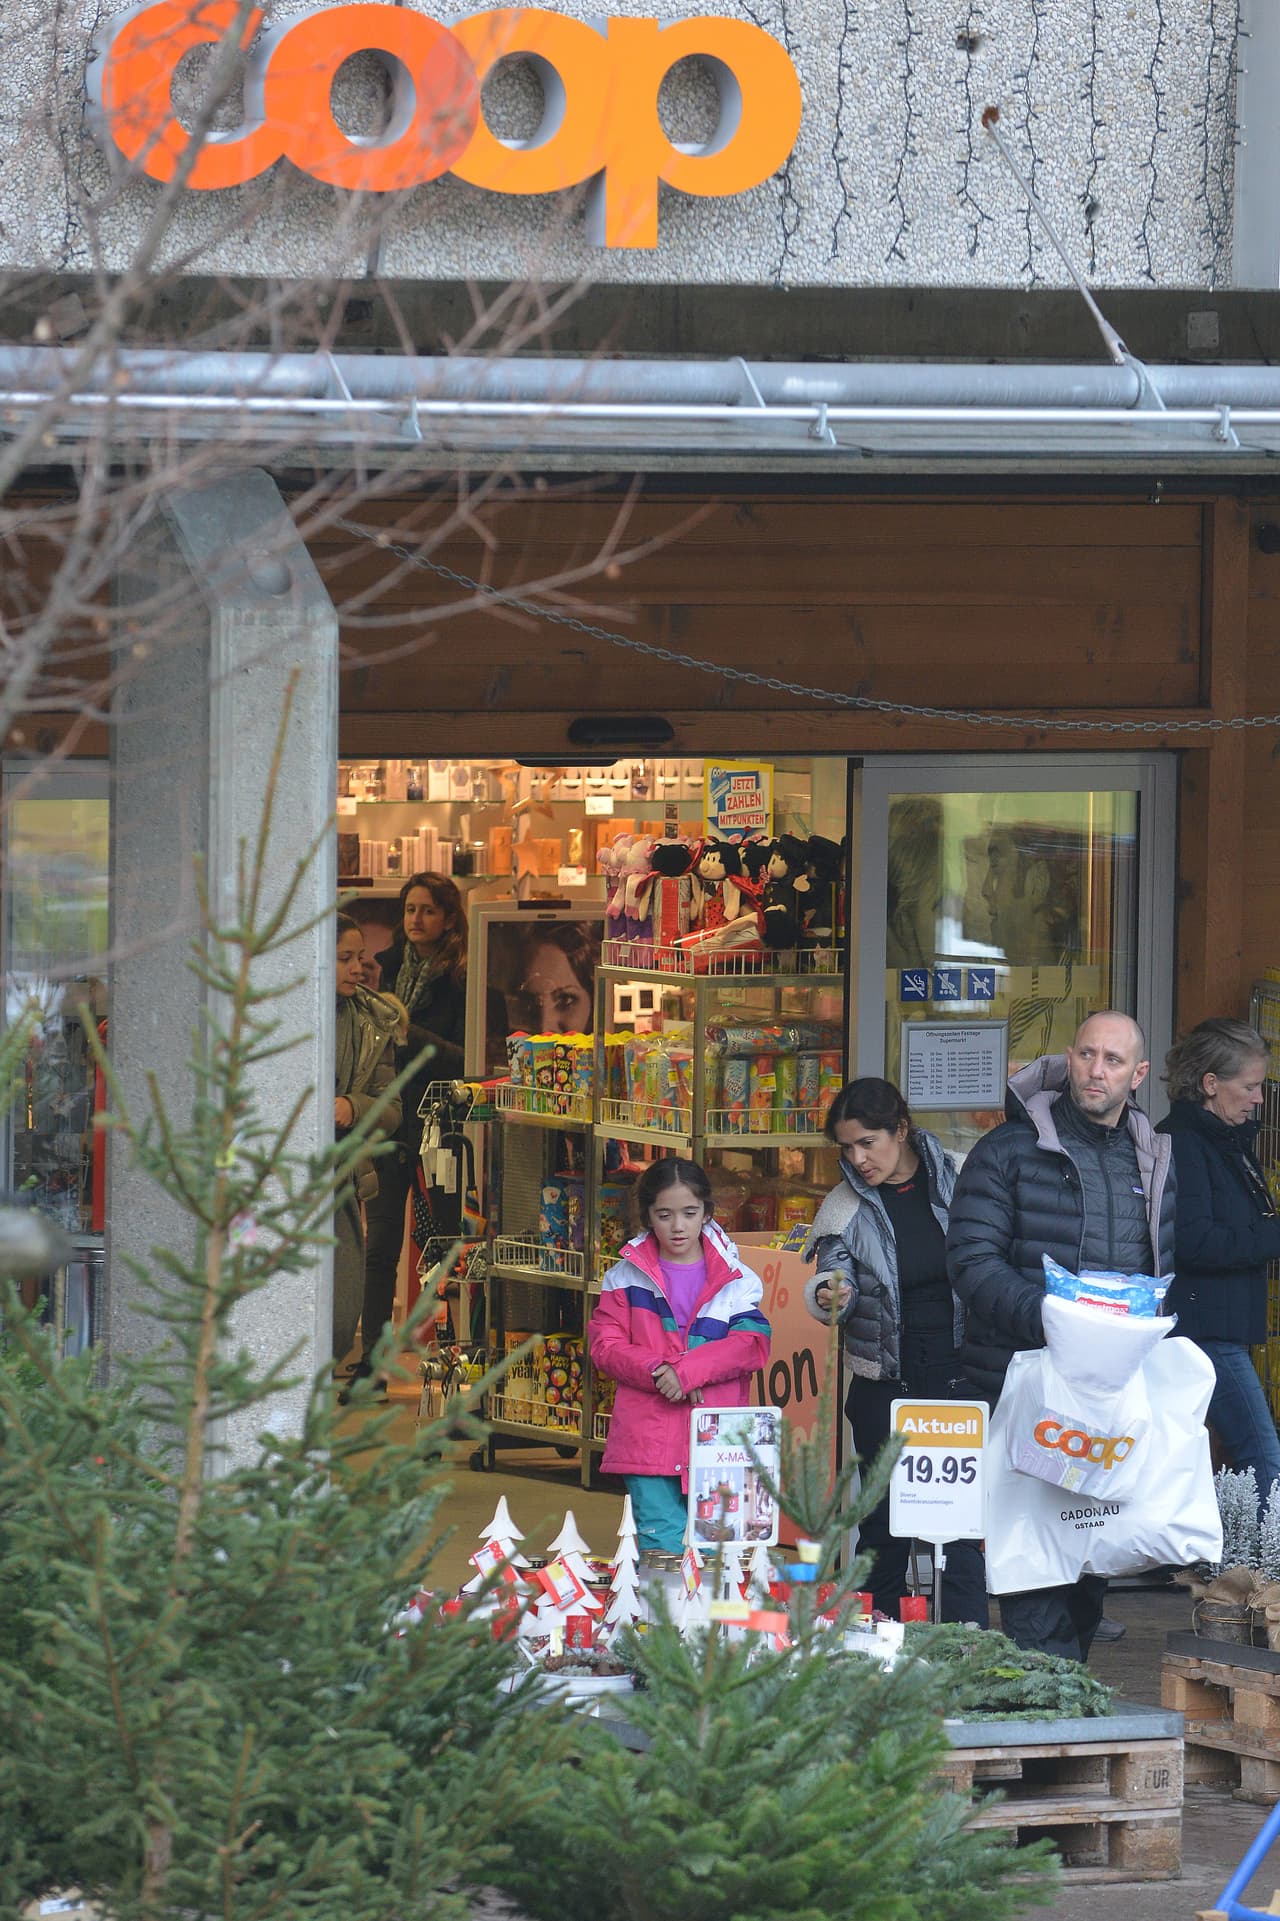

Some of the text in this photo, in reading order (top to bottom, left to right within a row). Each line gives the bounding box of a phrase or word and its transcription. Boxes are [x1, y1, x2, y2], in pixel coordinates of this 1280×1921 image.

[101, 0, 803, 249] coop
[732, 778, 755, 790] JETZT
[727, 793, 761, 811] ZAHLEN
[901, 1417, 977, 1435] Aktuell
[1033, 1420, 1135, 1470] coop
[900, 1455, 977, 1485] 19.95
[1060, 1504, 1120, 1521] CADONAU
[1074, 1520, 1105, 1530] GSTAAD
